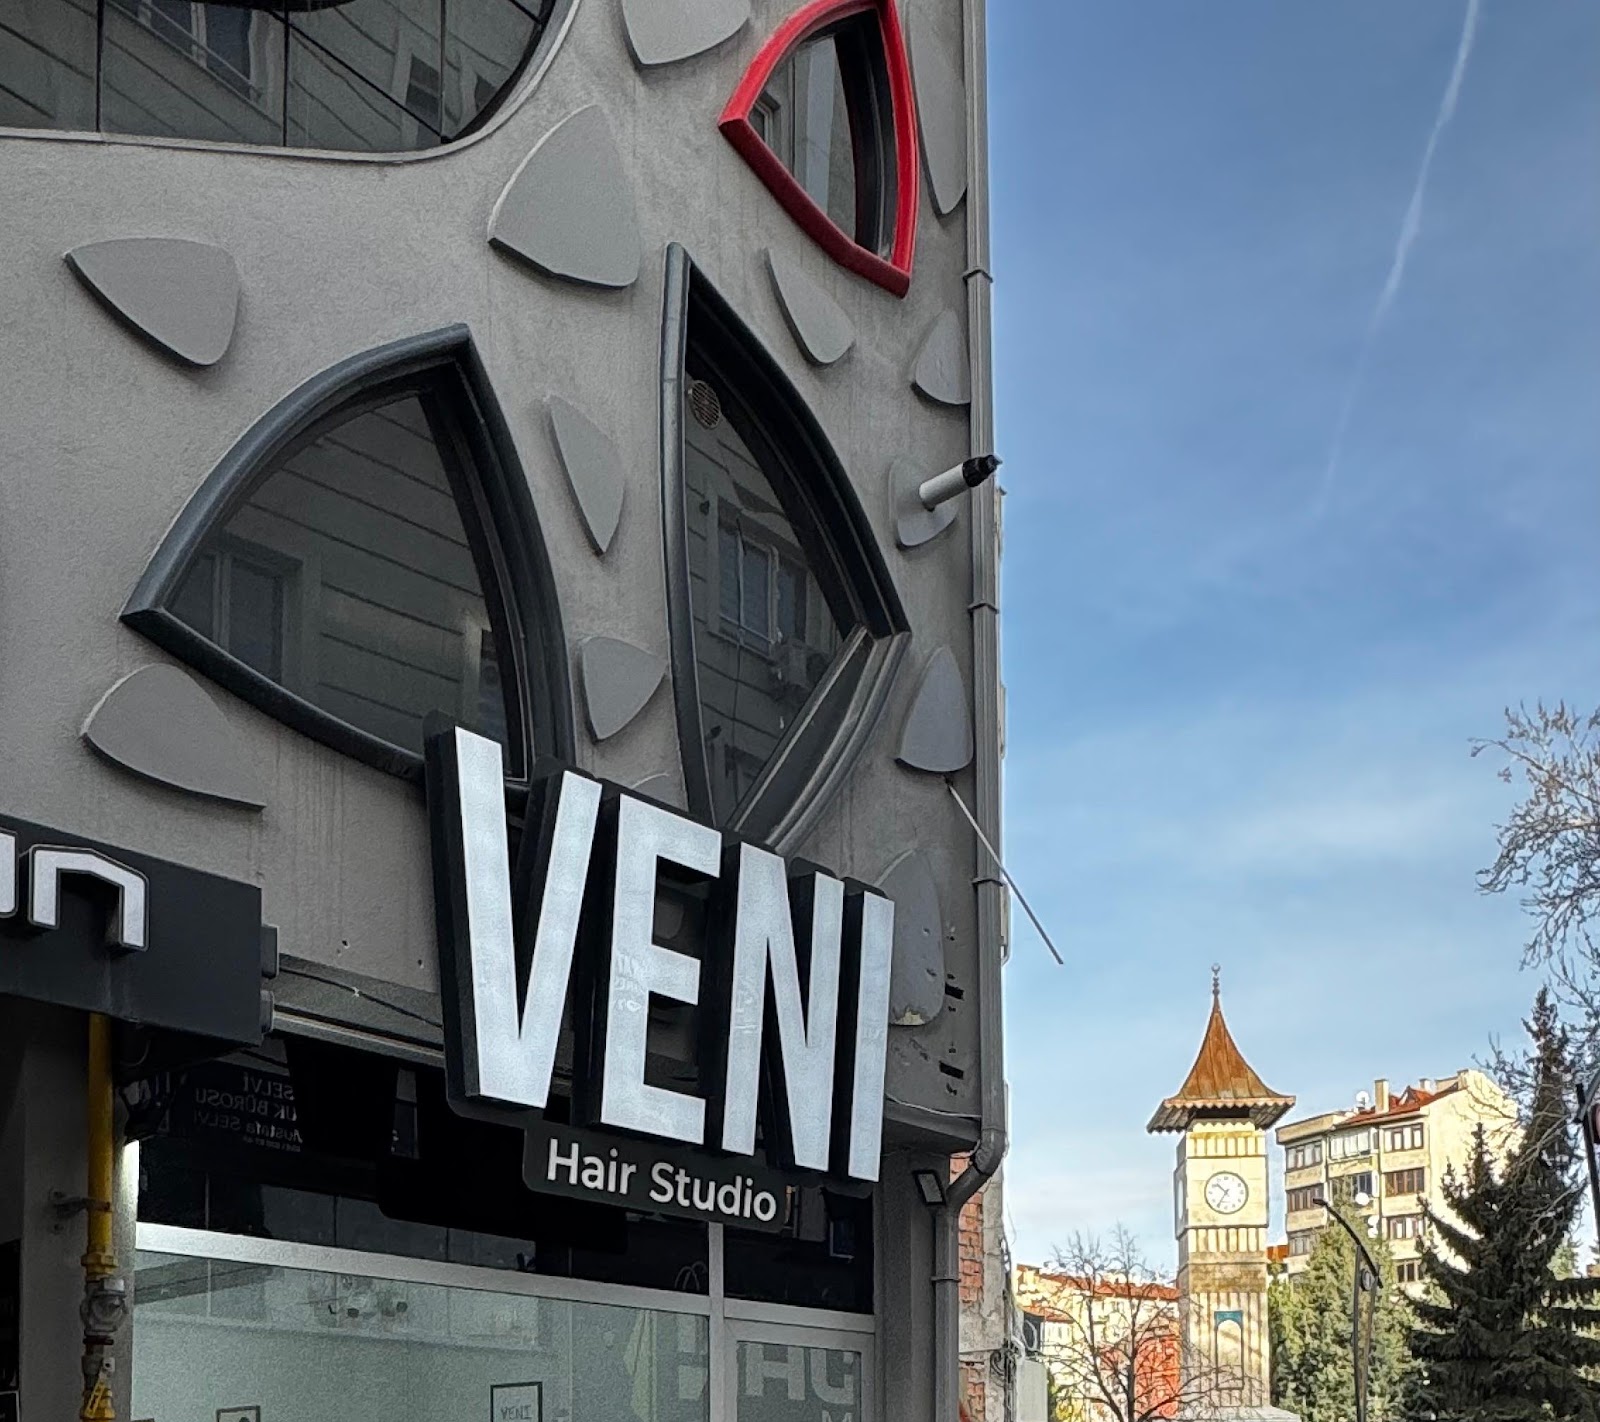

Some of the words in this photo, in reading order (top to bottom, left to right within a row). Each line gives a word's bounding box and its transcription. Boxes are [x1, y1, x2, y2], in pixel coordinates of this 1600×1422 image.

[455, 726, 895, 1182] VENI
[547, 1138, 637, 1195] Hair
[649, 1162, 777, 1222] Studio
